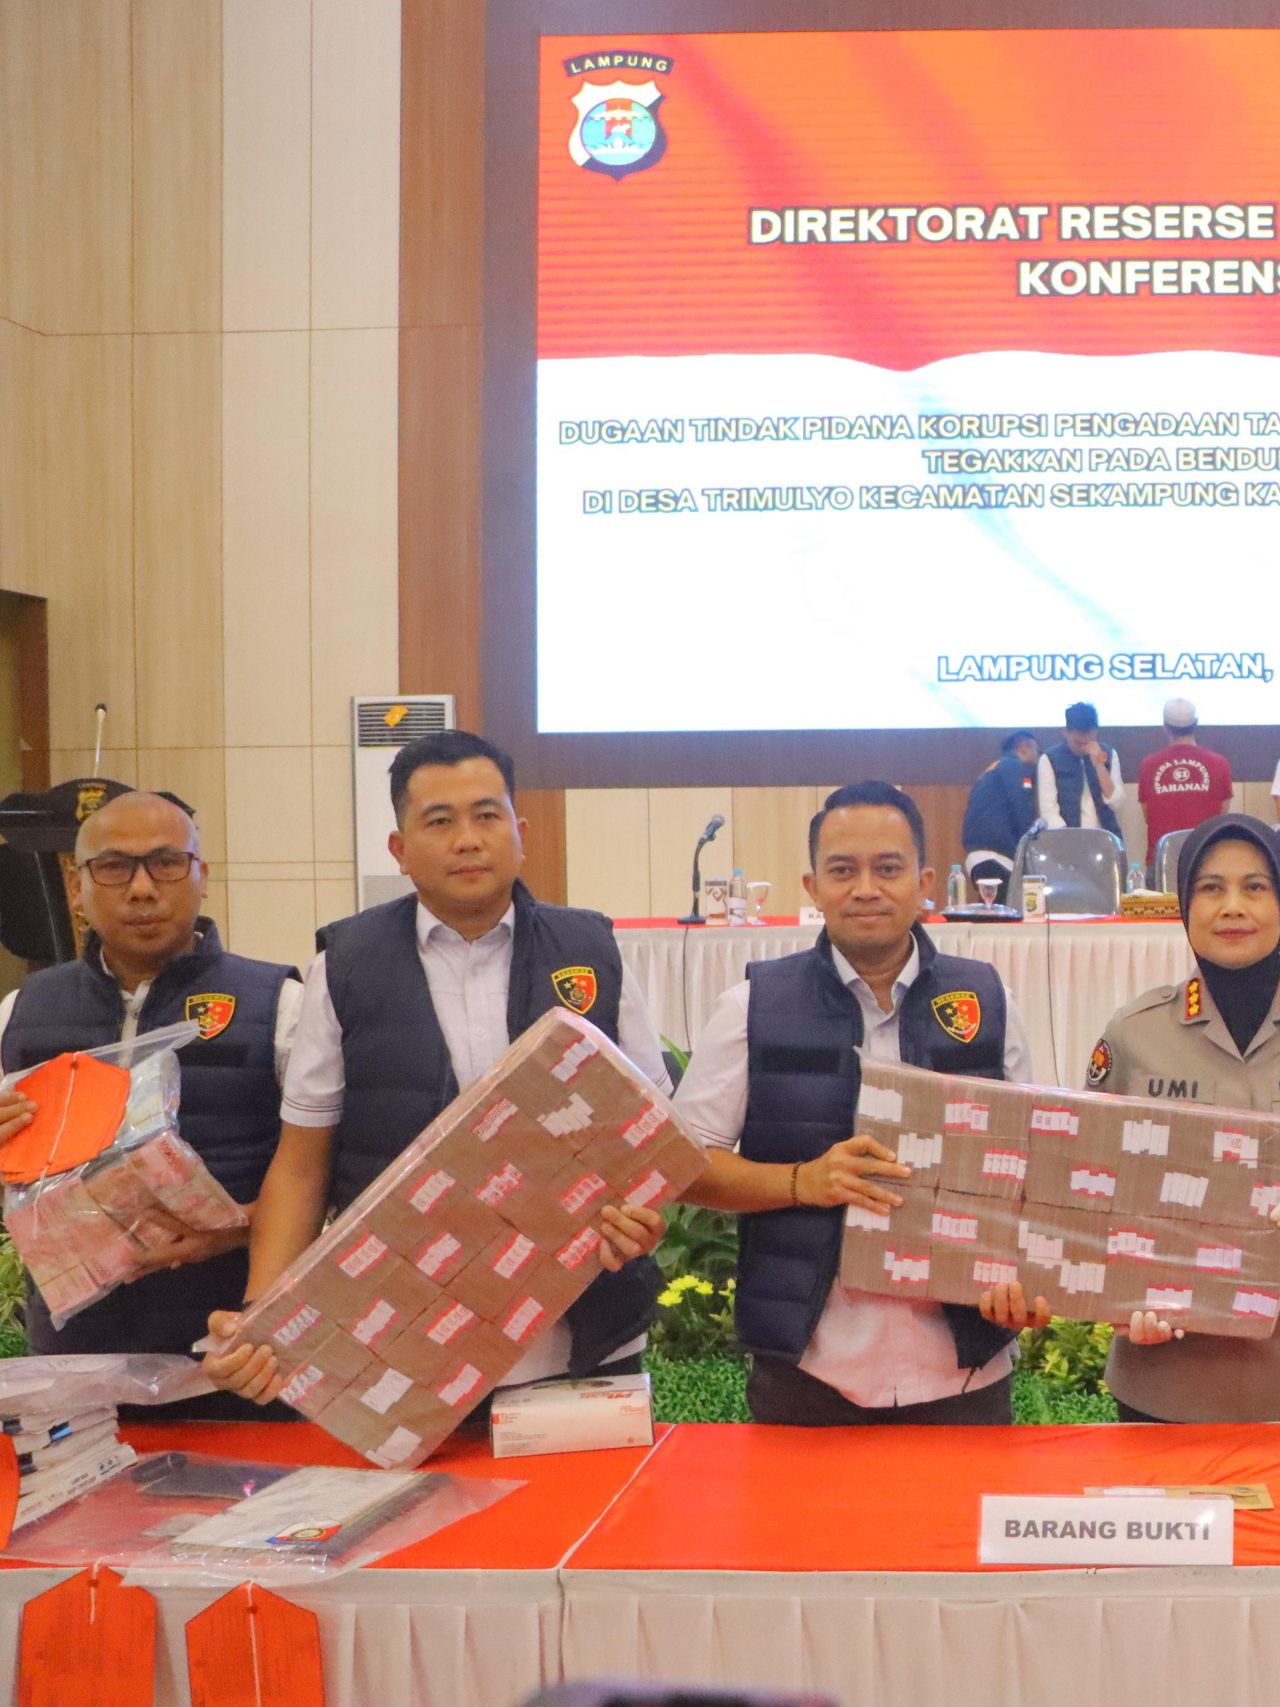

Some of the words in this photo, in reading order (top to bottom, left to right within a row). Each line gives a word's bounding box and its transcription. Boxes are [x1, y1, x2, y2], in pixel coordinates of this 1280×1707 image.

[570, 55, 668, 73] LAMPUNG
[749, 206, 1050, 244] DIREKTORAT
[1059, 204, 1276, 241] RESERSE
[559, 418, 684, 445] DUGAAN
[689, 417, 800, 442] TINDAK
[803, 415, 914, 440] PIDANA
[919, 413, 1048, 438] KORUPSI
[1054, 412, 1239, 437] PENGADAAN
[922, 448, 1082, 473] TEGAKKAN
[1089, 448, 1171, 472] PADA
[583, 490, 612, 514] DI
[619, 488, 698, 513] DESA
[702, 485, 853, 511] TRIMULYO
[859, 484, 1044, 510] KECAMATAN
[1050, 482, 1239, 507] SEKAMPUNG
[938, 653, 1103, 682] LAMPUNG
[1109, 653, 1273, 683] SELATAN,
[1174, 759, 1210, 786] LAMPUNG
[1155, 783, 1209, 794] TAHANAN
[1148, 1078, 1198, 1099] UMI
[1004, 1519, 1117, 1540] BARANG
[1126, 1521, 1210, 1541] BUKTI
